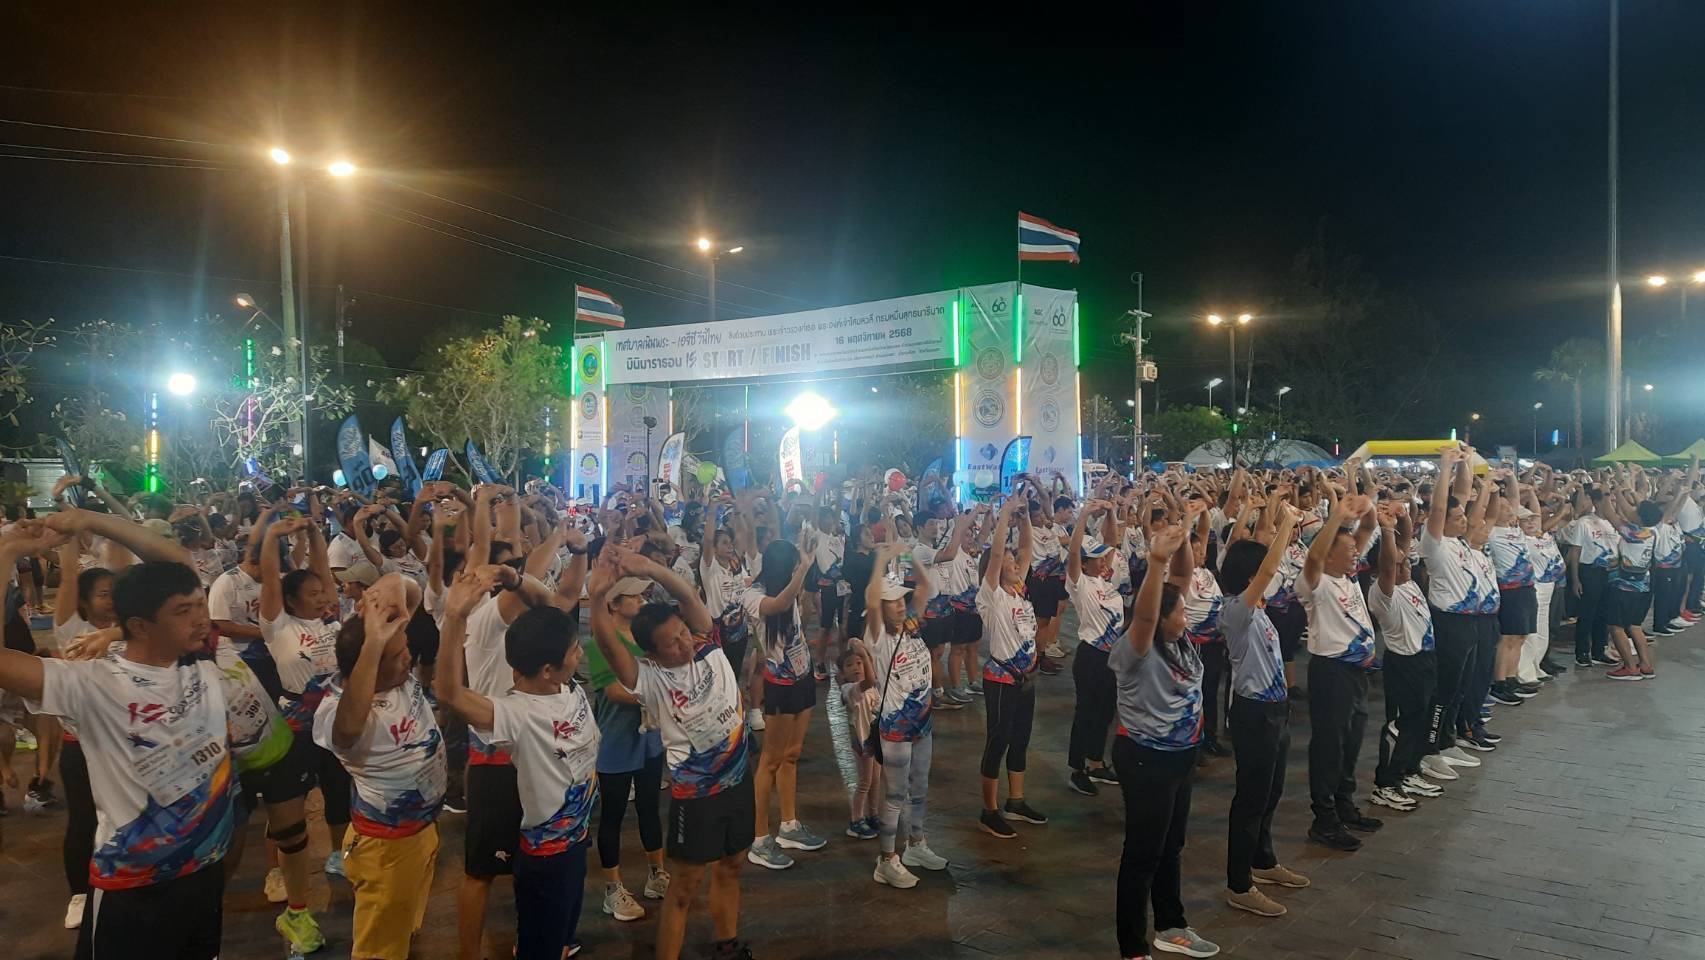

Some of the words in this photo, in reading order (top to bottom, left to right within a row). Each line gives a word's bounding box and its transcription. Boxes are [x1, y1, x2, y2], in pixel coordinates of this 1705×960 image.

[835, 336, 845, 345] 16
[889, 327, 912, 339] 2568
[626, 354, 682, 371] มินิมาราธอน
[703, 348, 744, 369] STRT
[762, 343, 811, 365] FINISH
[968, 463, 1001, 471] EastWa
[717, 705, 735, 725] 1204
[190, 742, 221, 766] 1310
